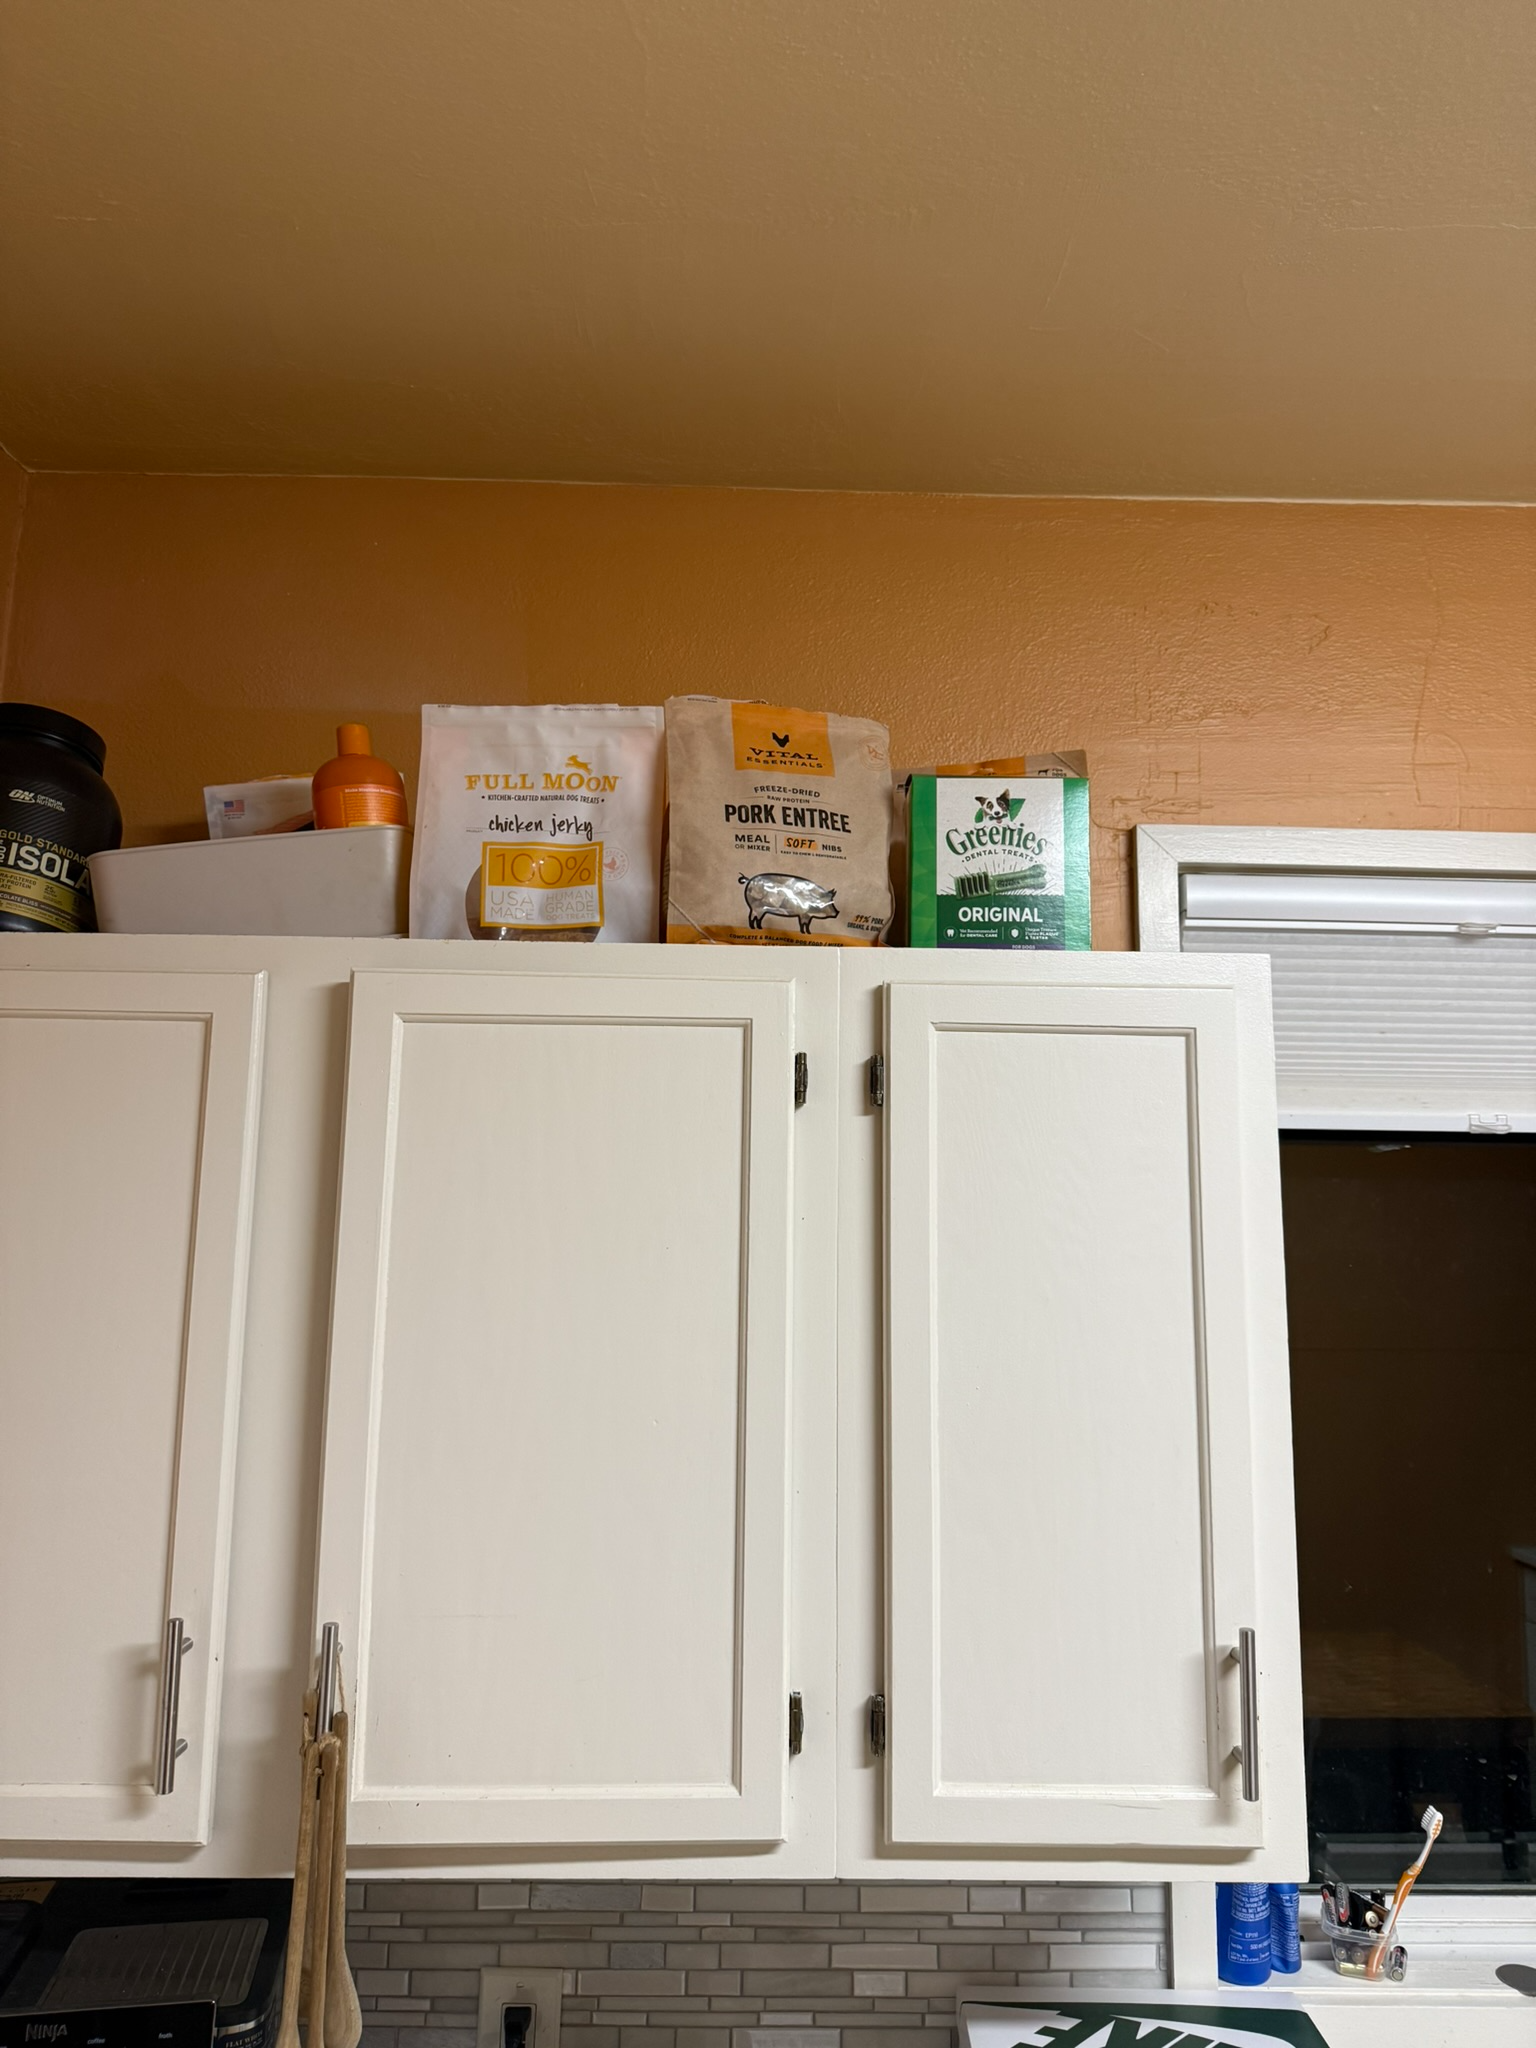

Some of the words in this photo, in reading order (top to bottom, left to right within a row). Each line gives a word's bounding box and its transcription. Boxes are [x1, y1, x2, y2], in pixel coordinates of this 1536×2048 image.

[750, 747, 818, 760] VITAL
[747, 756, 824, 768] ESSENTIALS
[464, 773, 535, 791] FULL
[542, 773, 619, 792] MOON
[754, 785, 820, 798] FREEZE-DRIED
[36, 799, 66, 812] NUTRITION
[37, 794, 63, 806] OPTIMUM
[488, 794, 540, 802] KITCHEN-CRAFTED
[580, 796, 600, 804] TREATS
[725, 804, 776, 824] PORK
[782, 806, 852, 833] ENTREE
[489, 814, 543, 833] chicken
[550, 813, 593, 842] jerky
[735, 834, 770, 844] MEAL
[786, 837, 815, 848] SOFT
[822, 843, 842, 852] NIBS
[945, 823, 1048, 856] Greenies
[0, 829, 33, 844] GOLD
[36, 838, 90, 867] STANDAR
[748, 844, 771, 852] MIXER
[965, 849, 998, 862] DENTAL
[1002, 849, 1034, 862] TREATS
[496, 852, 591, 885] 100%
[490, 890, 535, 908] USA
[545, 889, 594, 903] HUMAN
[490, 906, 535, 920] MADE
[545, 900, 595, 914] GRADE
[566, 913, 595, 921] TREATS
[958, 907, 1043, 922] ORIGINAL
[25, 2024, 68, 2043] NINJA
